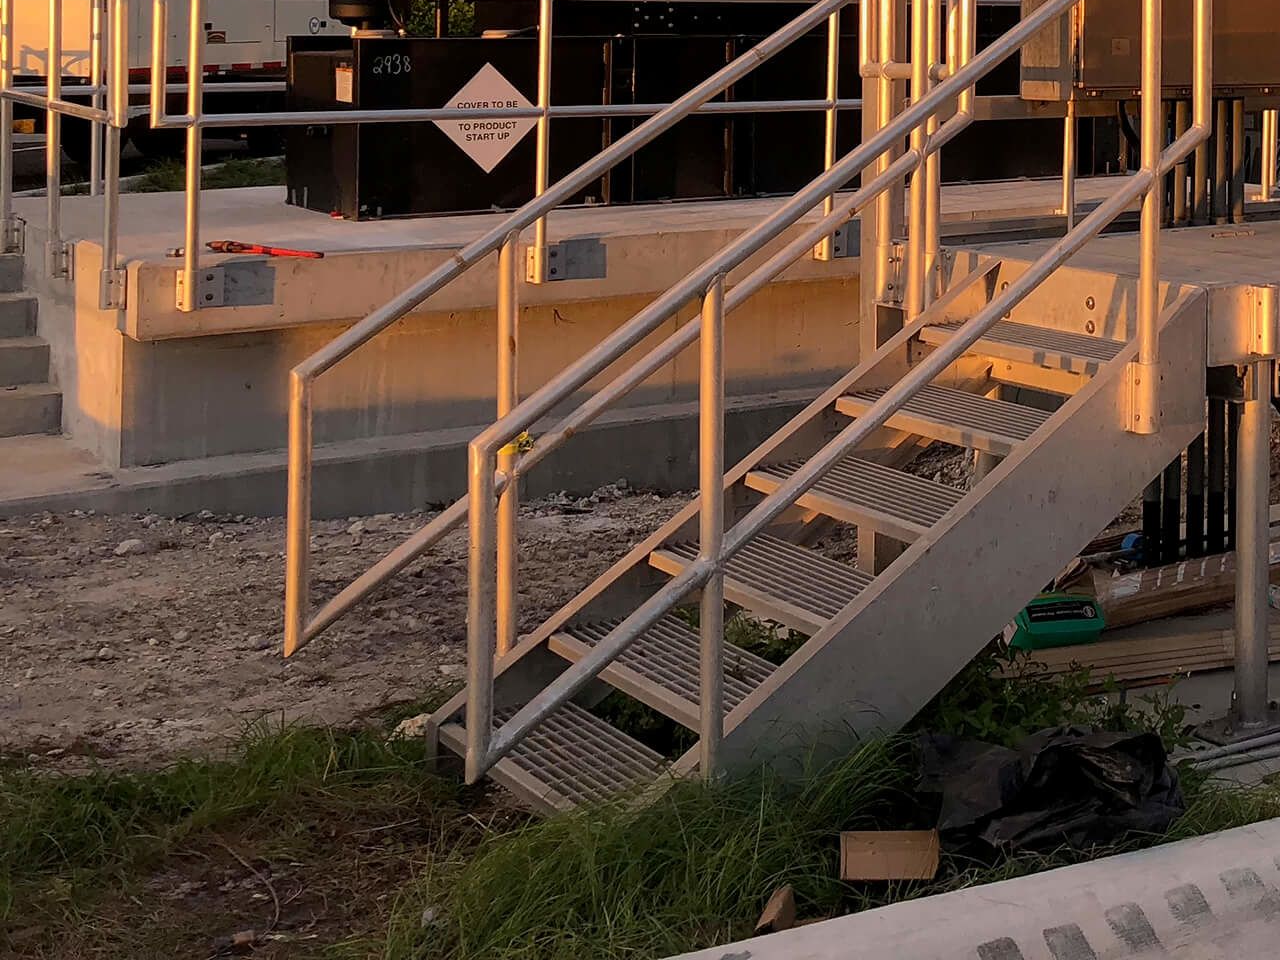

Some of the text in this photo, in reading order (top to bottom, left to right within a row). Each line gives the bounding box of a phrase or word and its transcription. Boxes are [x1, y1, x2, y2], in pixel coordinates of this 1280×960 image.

[373, 54, 411, 75] 2938
[506, 100, 519, 108] BE
[458, 121, 518, 131] TO PRODUCT
[465, 132, 510, 141] START UP
